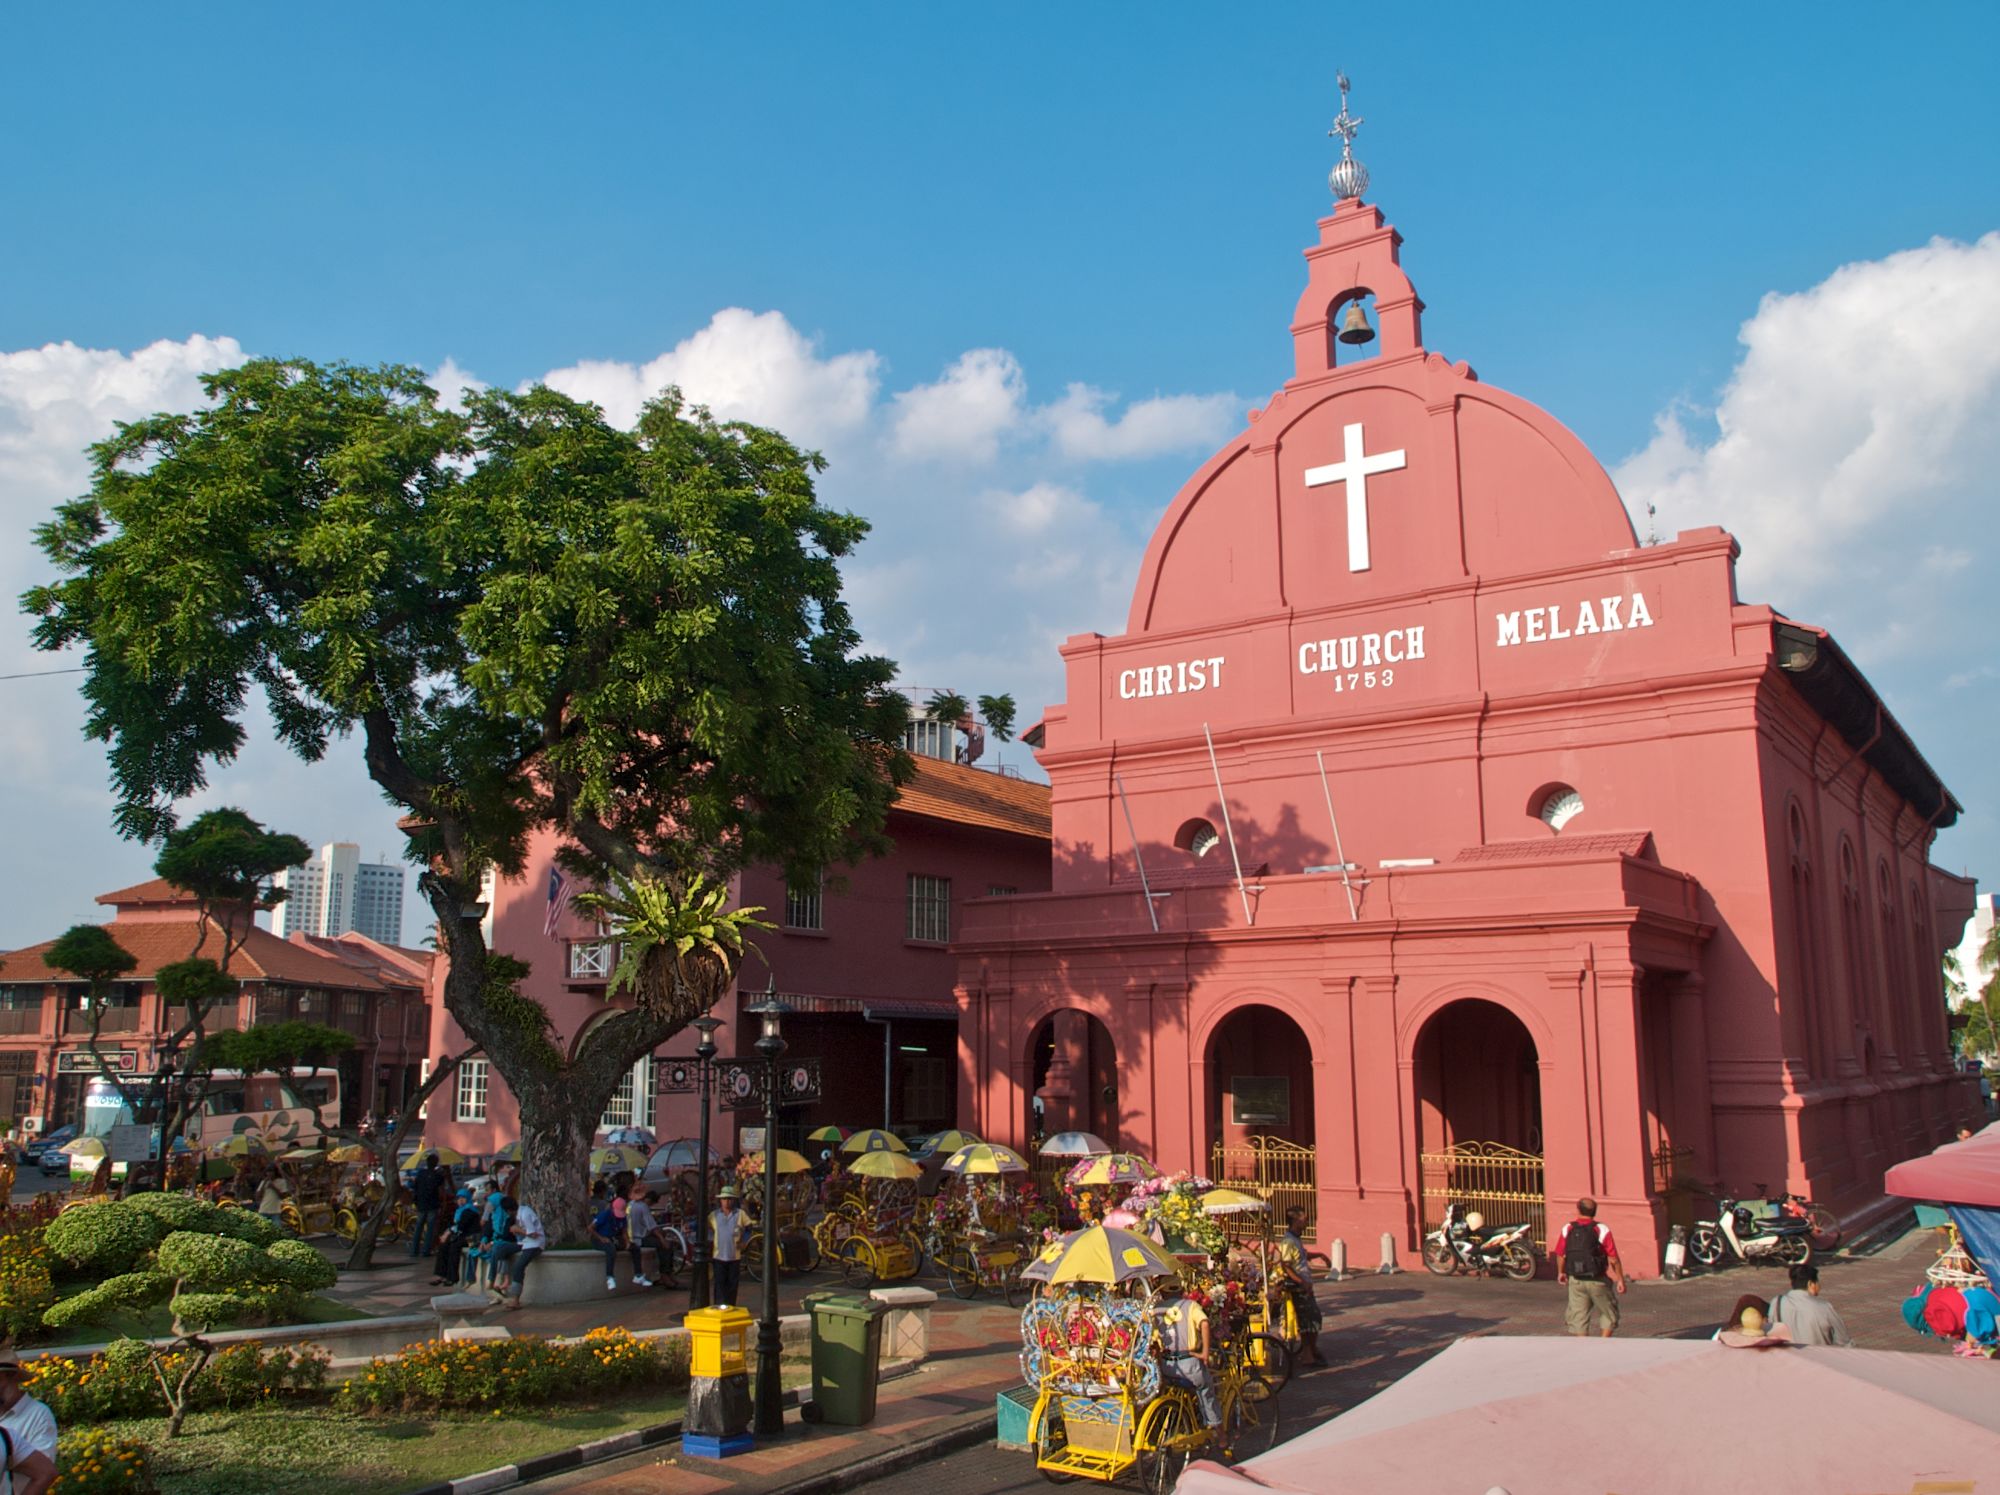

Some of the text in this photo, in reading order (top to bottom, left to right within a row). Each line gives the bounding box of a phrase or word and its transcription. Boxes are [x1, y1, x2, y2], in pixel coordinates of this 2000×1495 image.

[1119, 592, 1655, 699] CHRIST CHURCH MELAKA
[1334, 669, 1395, 693] 1753
